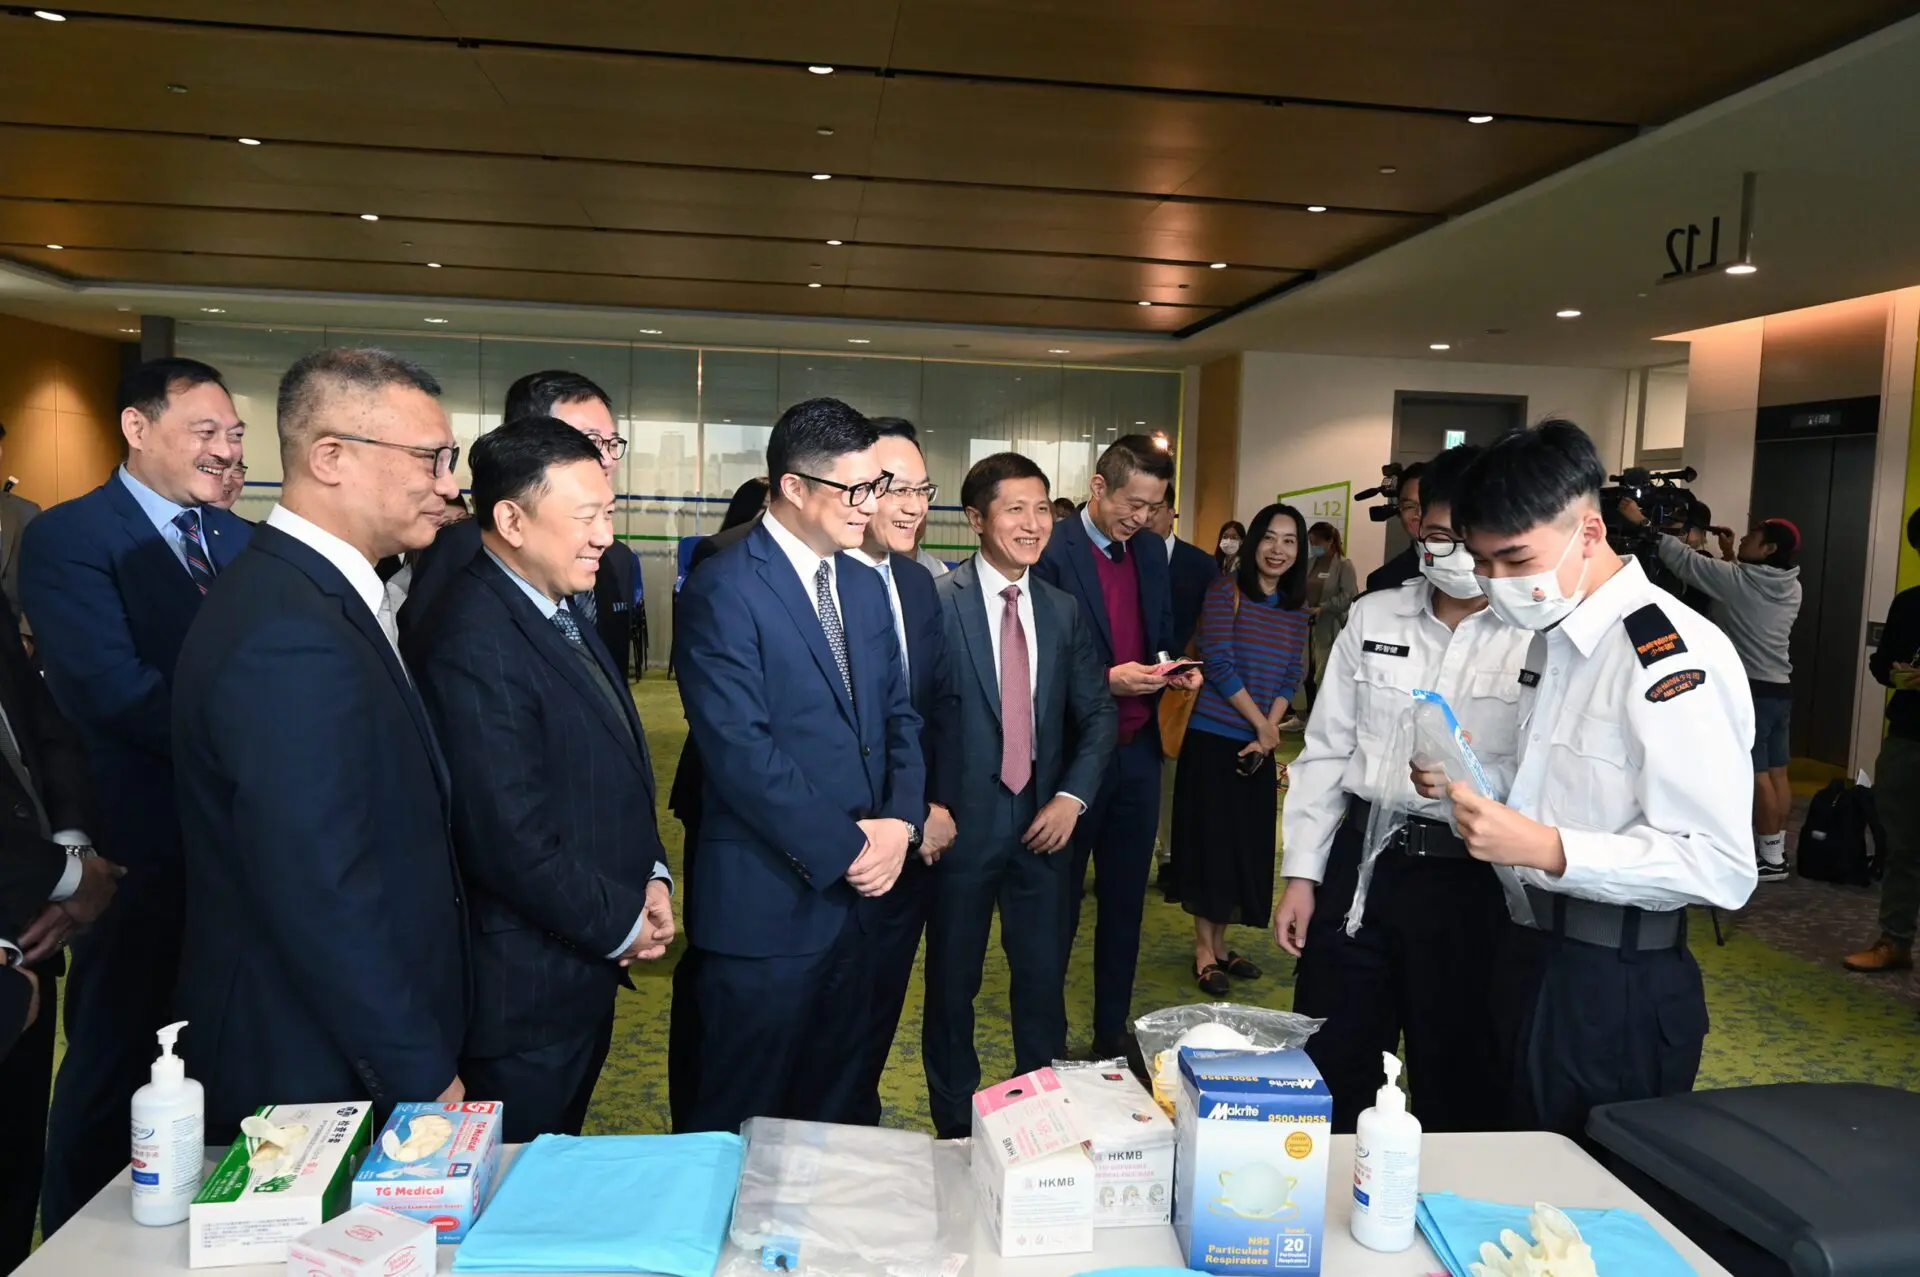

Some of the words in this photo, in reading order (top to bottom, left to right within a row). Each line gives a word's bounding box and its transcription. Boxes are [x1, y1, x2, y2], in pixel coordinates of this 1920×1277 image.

[1313, 500, 1342, 516] L12
[1207, 1102, 1259, 1120] Makrite
[1268, 1114, 1327, 1124] 9500-N95S
[1108, 1151, 1143, 1161] HKMB
[1038, 1177, 1075, 1188] HKMB
[375, 1187, 392, 1196] TG
[395, 1185, 445, 1196] Medical
[1248, 1236, 1270, 1246] N95
[1283, 1238, 1304, 1252] 20
[1208, 1244, 1270, 1255] Particulate
[1204, 1254, 1269, 1265] Respirators
